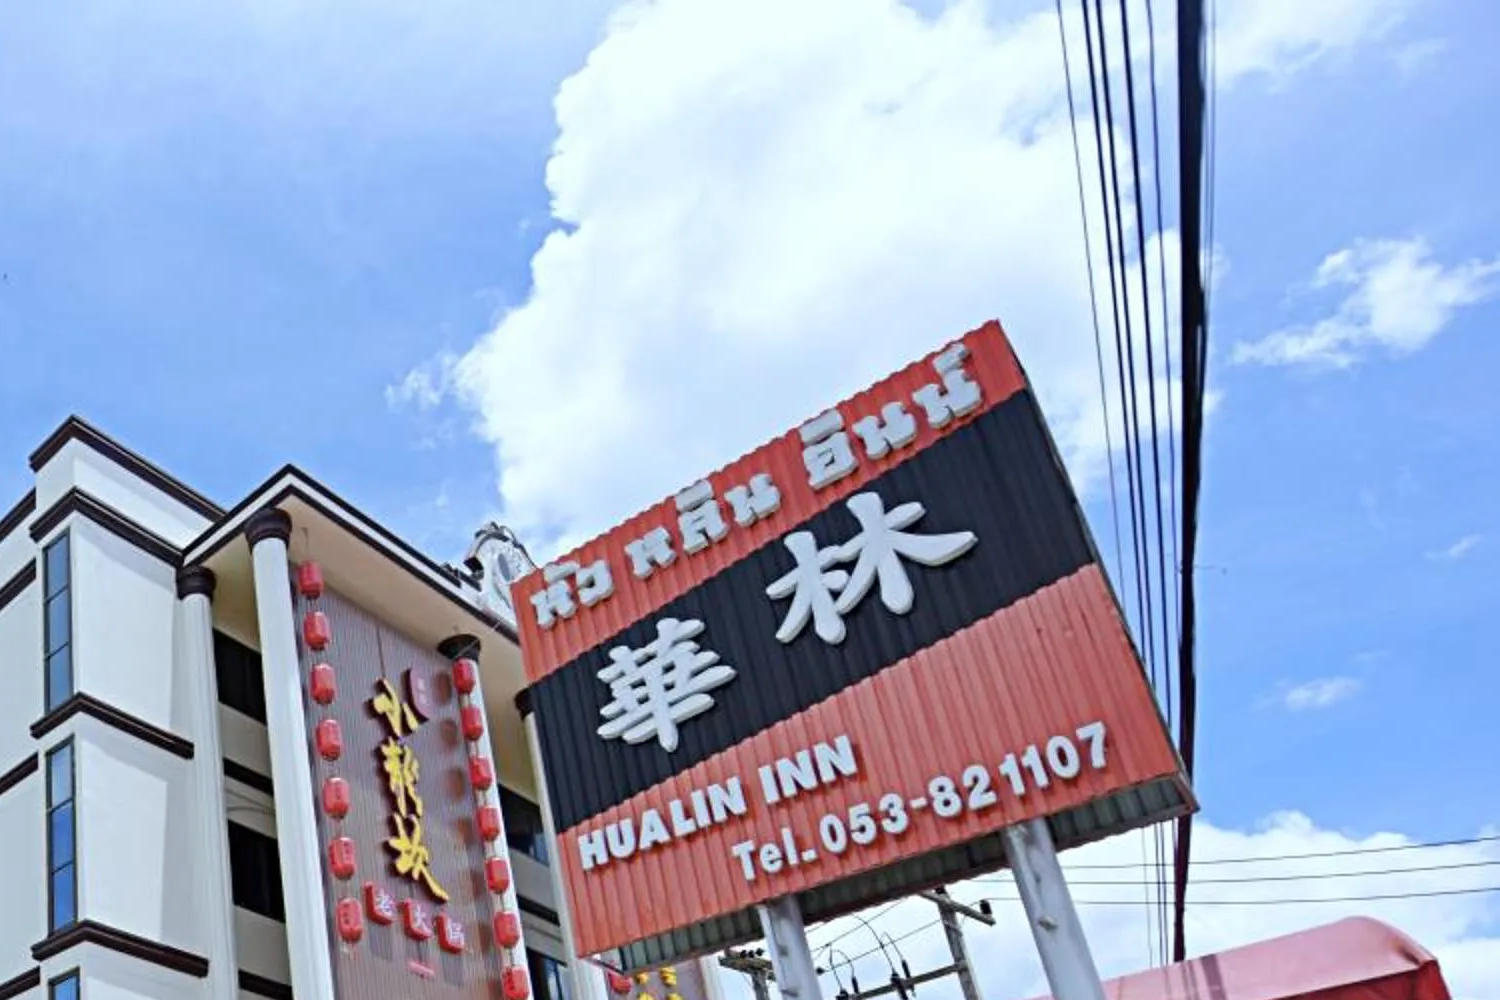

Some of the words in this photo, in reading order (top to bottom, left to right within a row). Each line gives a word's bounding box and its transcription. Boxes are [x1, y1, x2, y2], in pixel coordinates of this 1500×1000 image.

[530, 558, 613, 629] หัว
[626, 473, 780, 579] หลิน
[597, 492, 978, 753] 華林
[578, 776, 747, 871] HUALIN
[757, 735, 857, 804] INN
